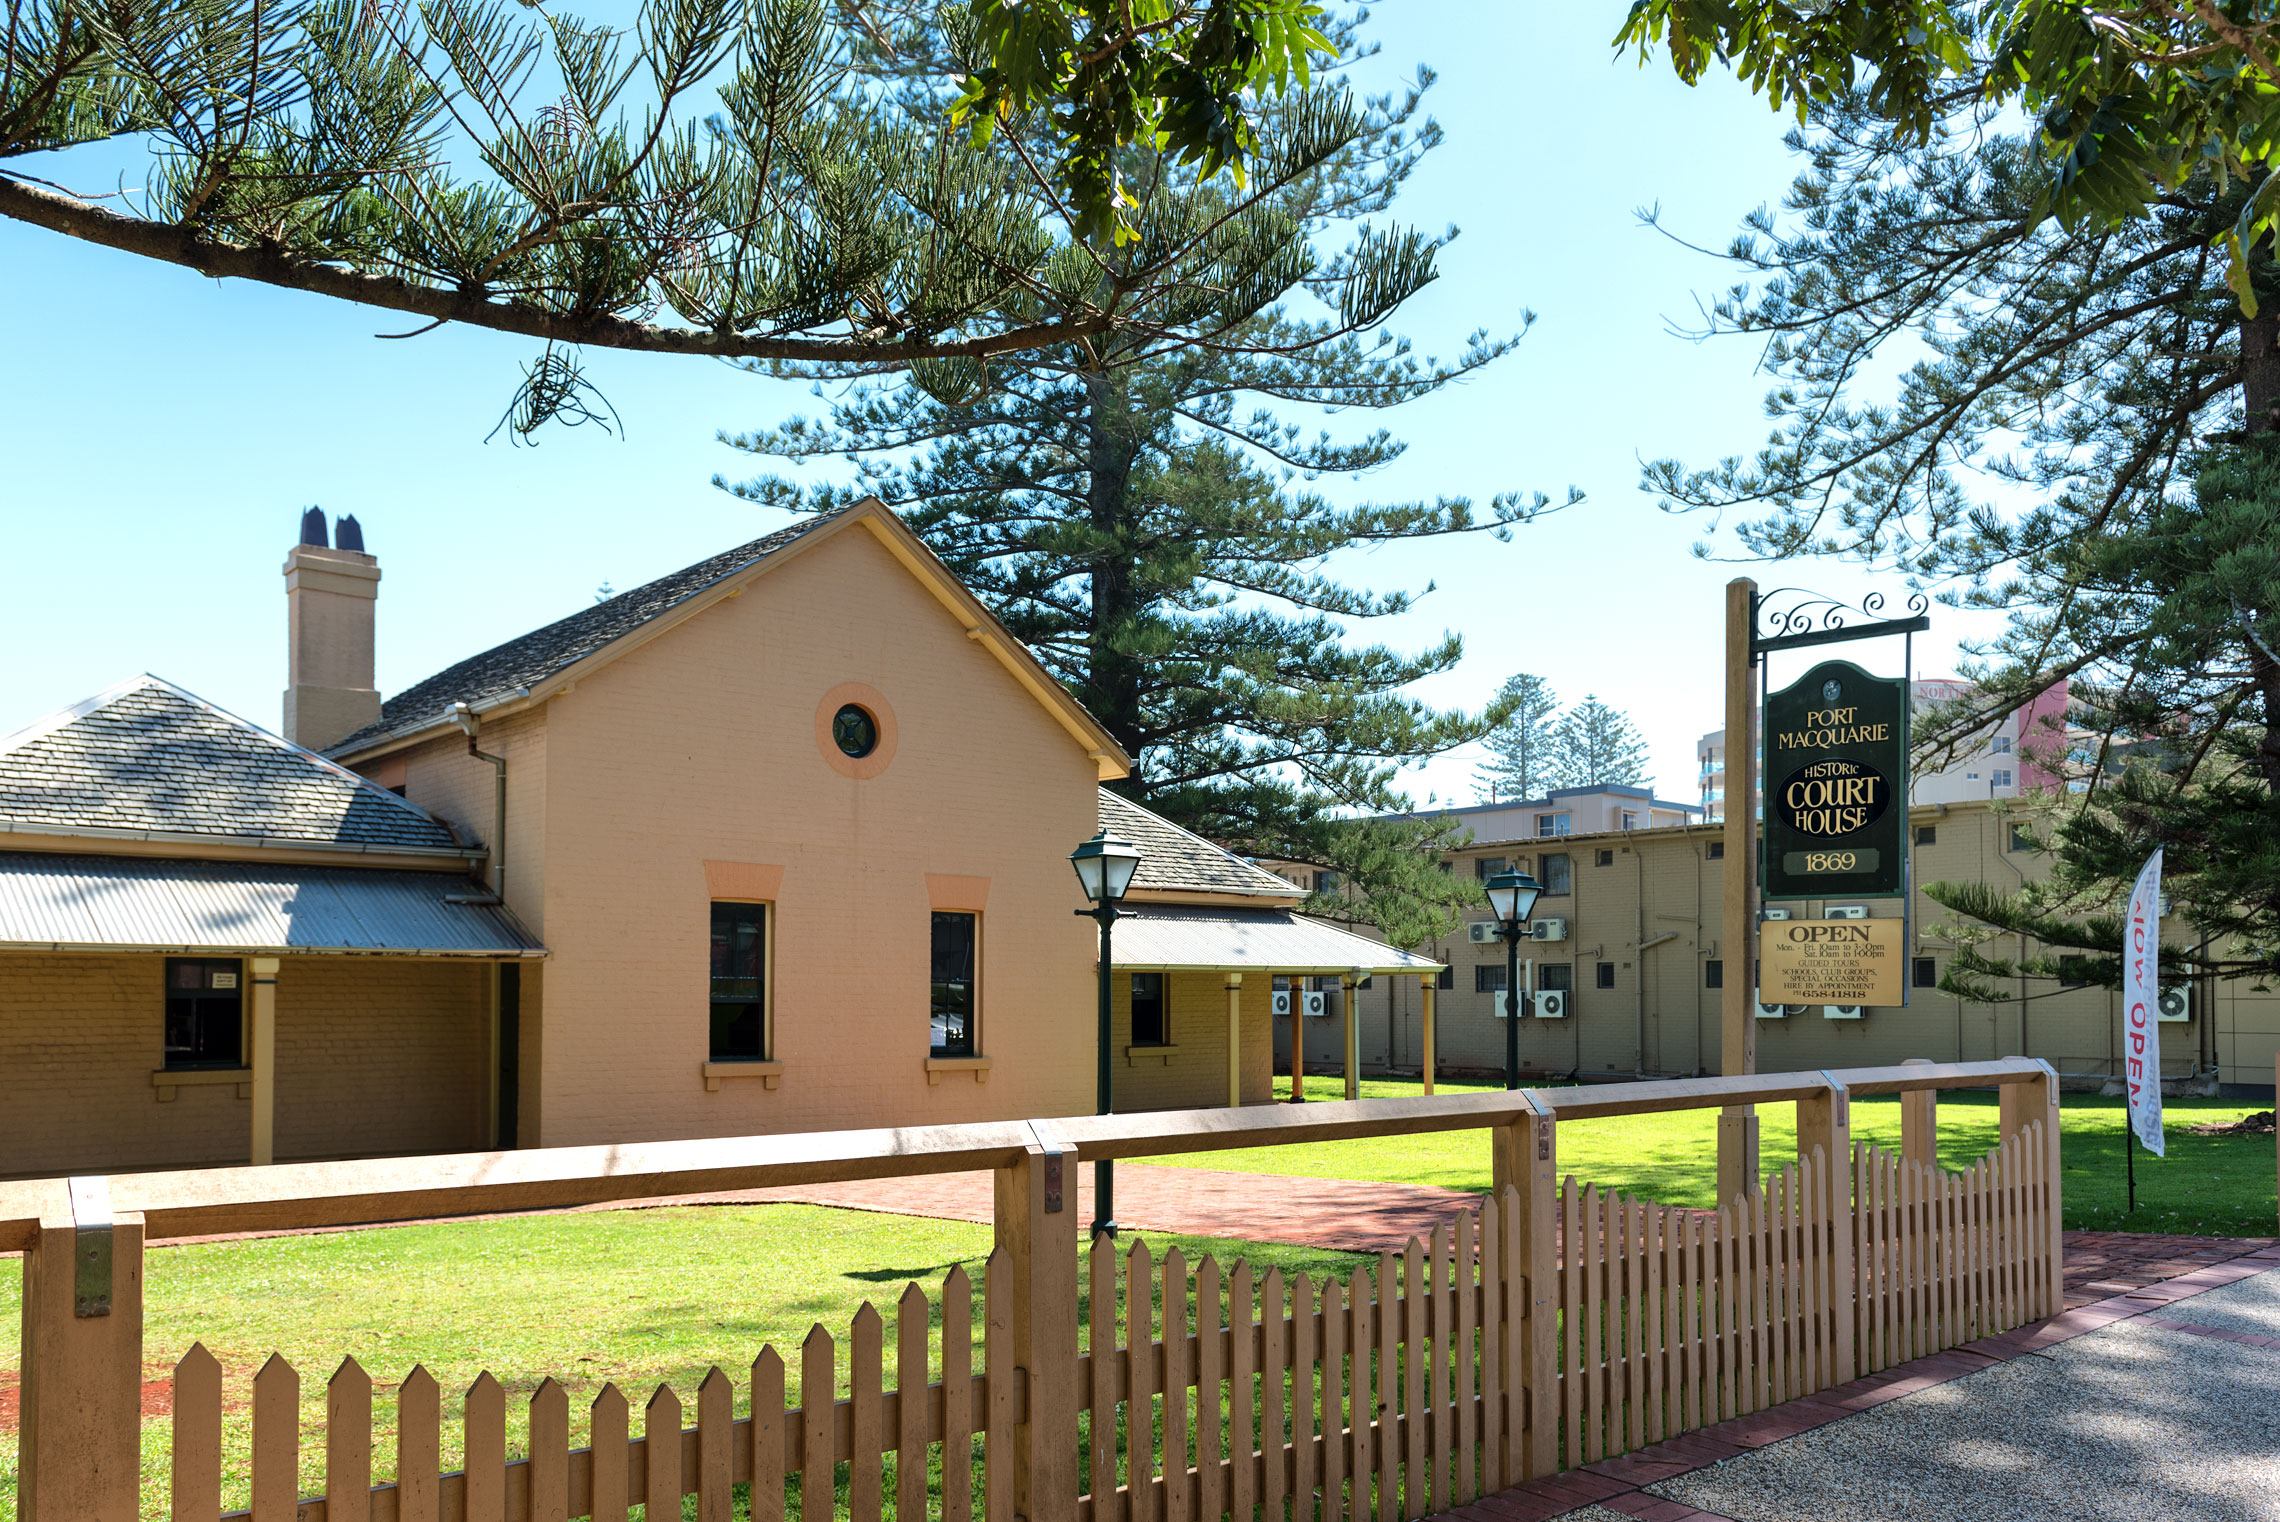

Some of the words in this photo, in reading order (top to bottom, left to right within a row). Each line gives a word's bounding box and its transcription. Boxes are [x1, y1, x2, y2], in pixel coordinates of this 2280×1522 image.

[1807, 707, 1858, 728] PORT
[1778, 723, 1889, 749] MACQUARIE
[1804, 762, 1859, 778] HISTORIC
[1787, 776, 1880, 809] COURT
[1795, 807, 1867, 835] HOUSE
[1805, 852, 1856, 872] 1869
[1788, 925, 1872, 943] OPEN
[1804, 943, 1816, 951] Fri.
[1819, 943, 1840, 951] 10am
[1843, 943, 1851, 951] to
[1804, 950, 1818, 958] Sat.
[1819, 950, 1840, 958] 10am
[2128, 1002, 2146, 1106] OPEN
